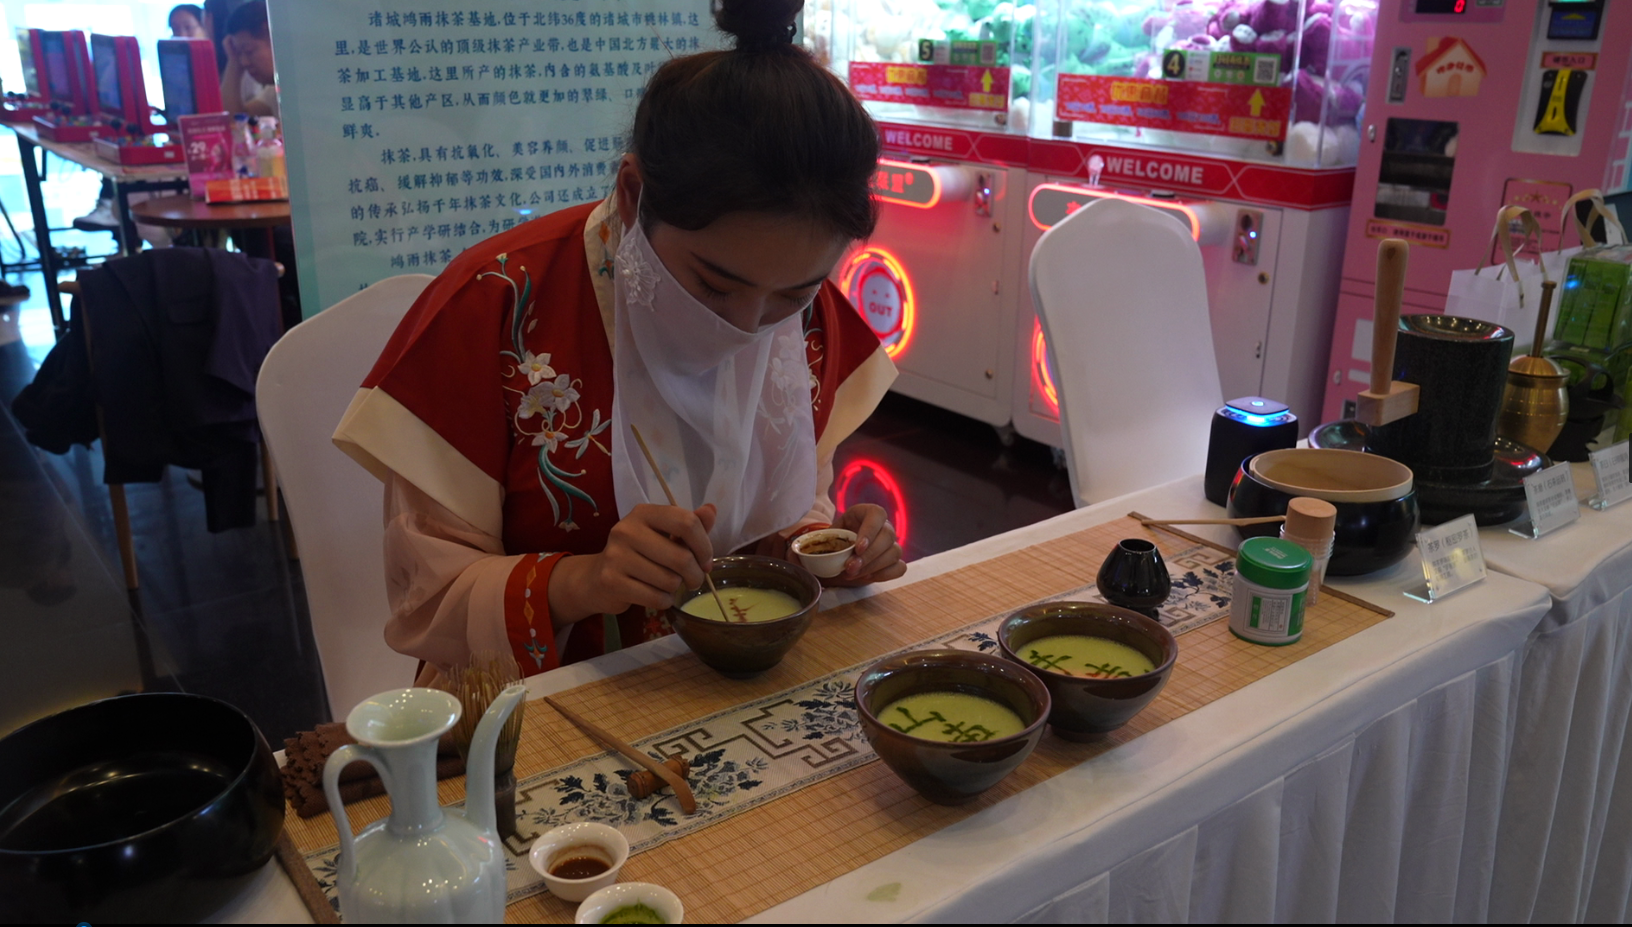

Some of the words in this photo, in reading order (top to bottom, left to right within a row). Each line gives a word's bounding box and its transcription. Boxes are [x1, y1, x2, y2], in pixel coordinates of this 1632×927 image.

[921, 41, 932, 60] 5
[1166, 52, 1180, 75] 4
[884, 129, 954, 151] WELCOME
[1106, 155, 1204, 185] WELCOME
[868, 301, 893, 317] OUT
